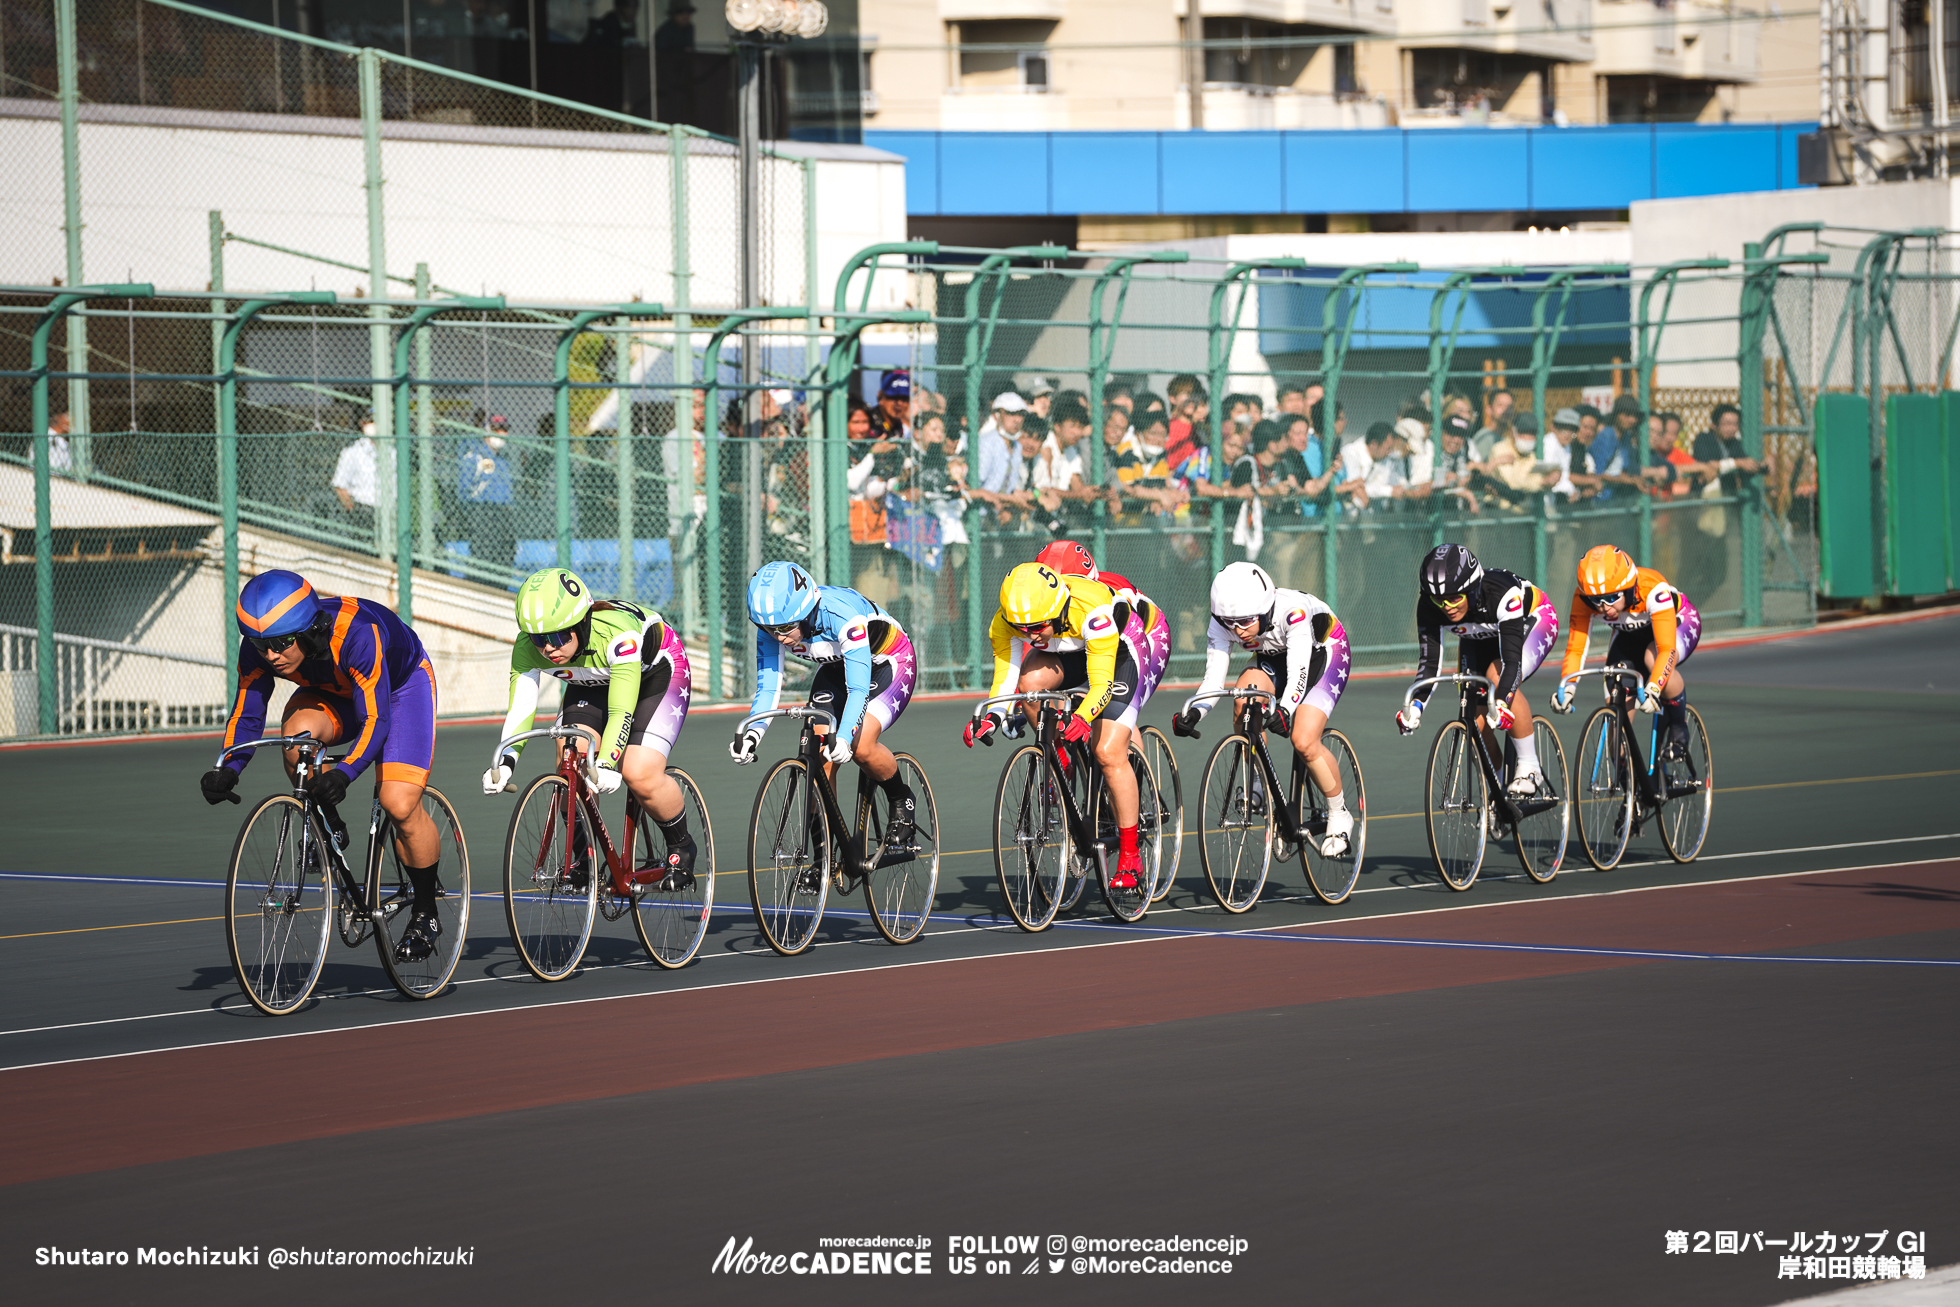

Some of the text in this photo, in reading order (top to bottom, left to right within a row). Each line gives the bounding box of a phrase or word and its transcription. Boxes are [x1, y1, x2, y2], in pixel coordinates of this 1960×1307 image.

[1074, 544, 1092, 570] 3
[1458, 546, 1478, 569] 2
[559, 573, 581, 597] 6
[790, 566, 808, 592] 4
[1037, 566, 1059, 589] 5
[1252, 568, 1267, 592] 1
[1097, 680, 1113, 710] KEIRIN
[615, 711, 633, 751] KEIRIN
